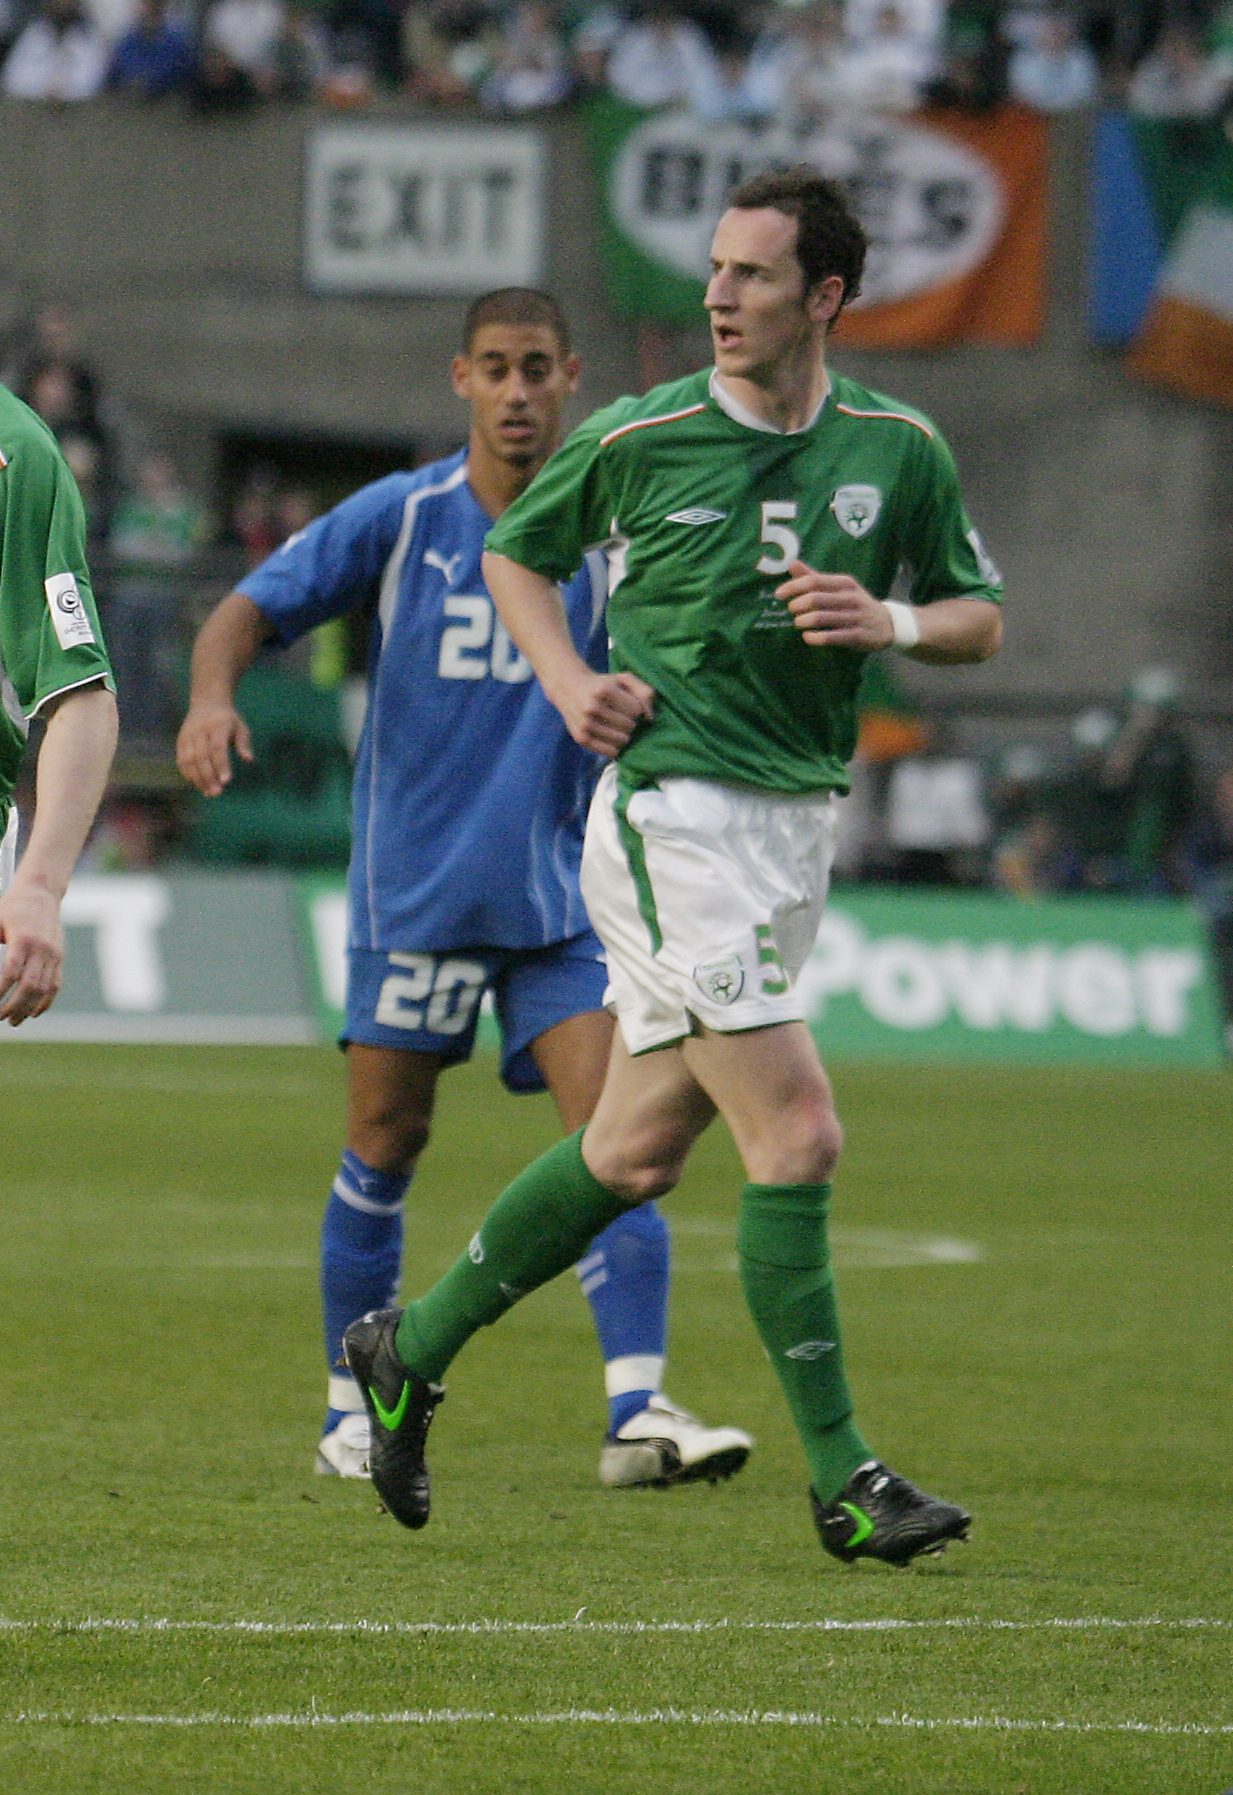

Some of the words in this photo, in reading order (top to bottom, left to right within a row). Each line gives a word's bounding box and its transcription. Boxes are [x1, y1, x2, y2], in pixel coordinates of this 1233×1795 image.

[328, 163, 517, 256] EXIT
[756, 501, 801, 576] 5
[374, 951, 487, 1035] 20
[753, 923, 788, 995] 5
